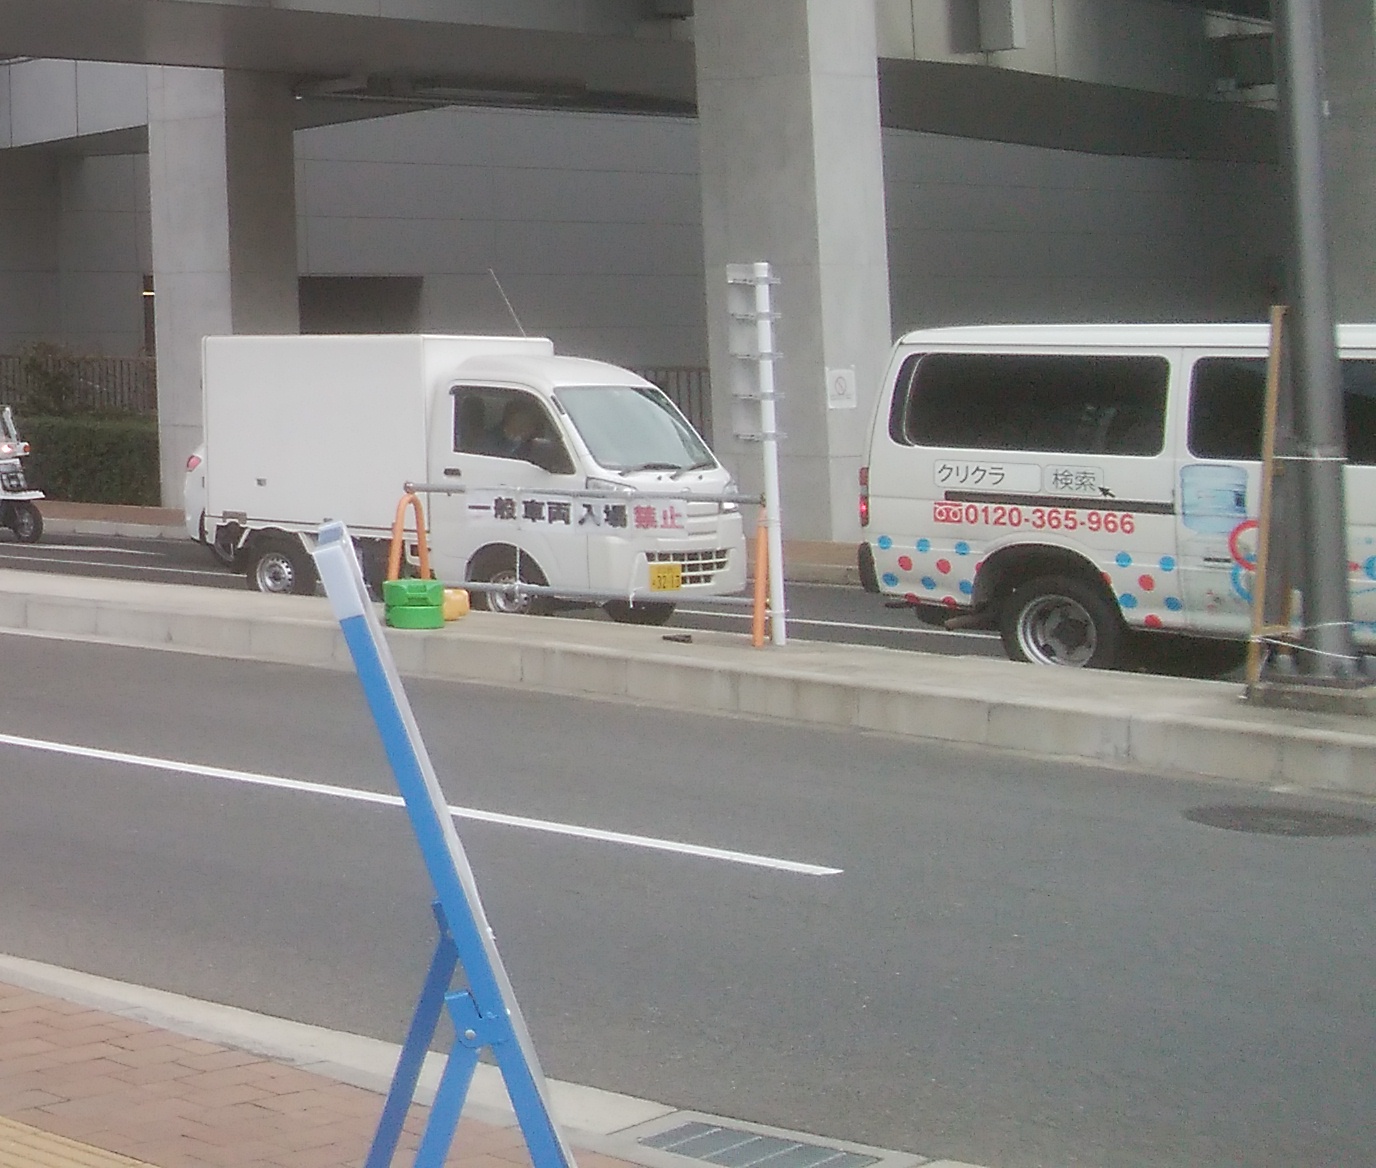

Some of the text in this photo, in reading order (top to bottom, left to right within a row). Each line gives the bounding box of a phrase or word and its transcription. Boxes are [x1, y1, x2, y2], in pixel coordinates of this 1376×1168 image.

[938, 463, 1097, 492] クリクラ 検索
[964, 503, 1135, 535] 0120-365-966
